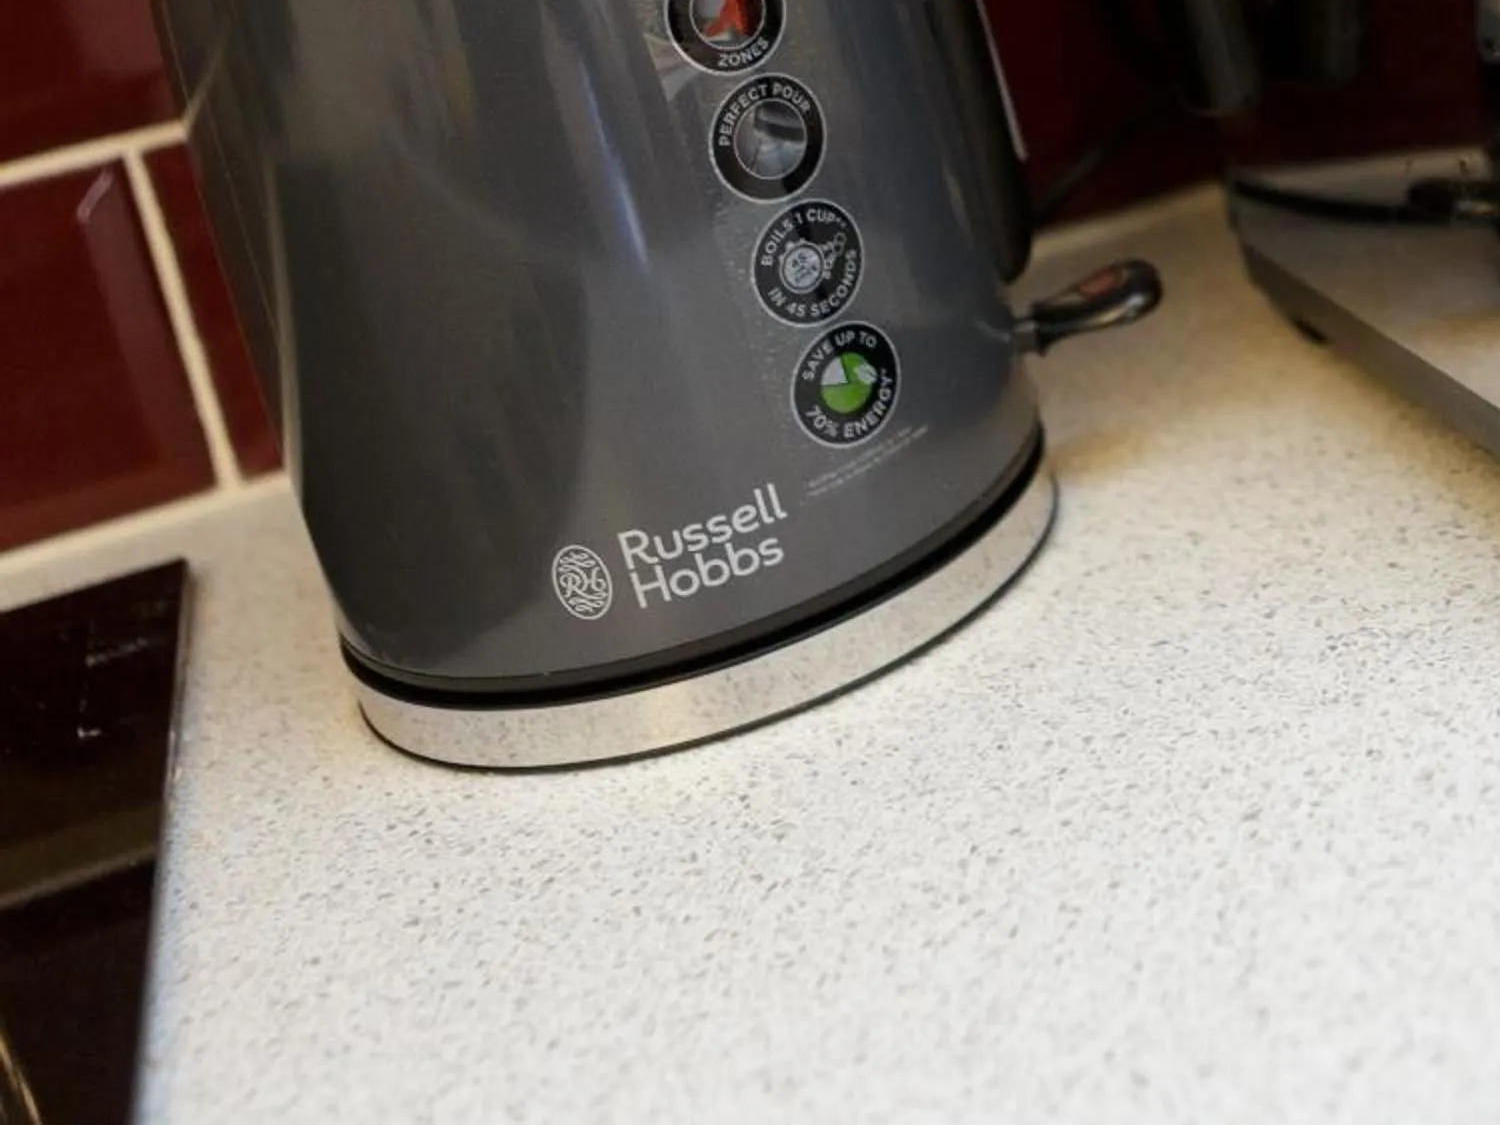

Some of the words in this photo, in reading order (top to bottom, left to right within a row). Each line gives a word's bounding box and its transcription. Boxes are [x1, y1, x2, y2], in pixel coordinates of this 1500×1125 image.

[717, 36, 770, 68] ZONES
[718, 83, 769, 147] PERFECT
[772, 82, 812, 113] POUR
[760, 217, 794, 267] BOILS
[768, 287, 783, 308] IN
[811, 248, 858, 317] SECONDS
[802, 337, 835, 382] SAVE
[835, 331, 856, 346] UP
[858, 331, 878, 349] TO
[616, 482, 788, 570] Russell
[629, 536, 785, 610] Hobbs
